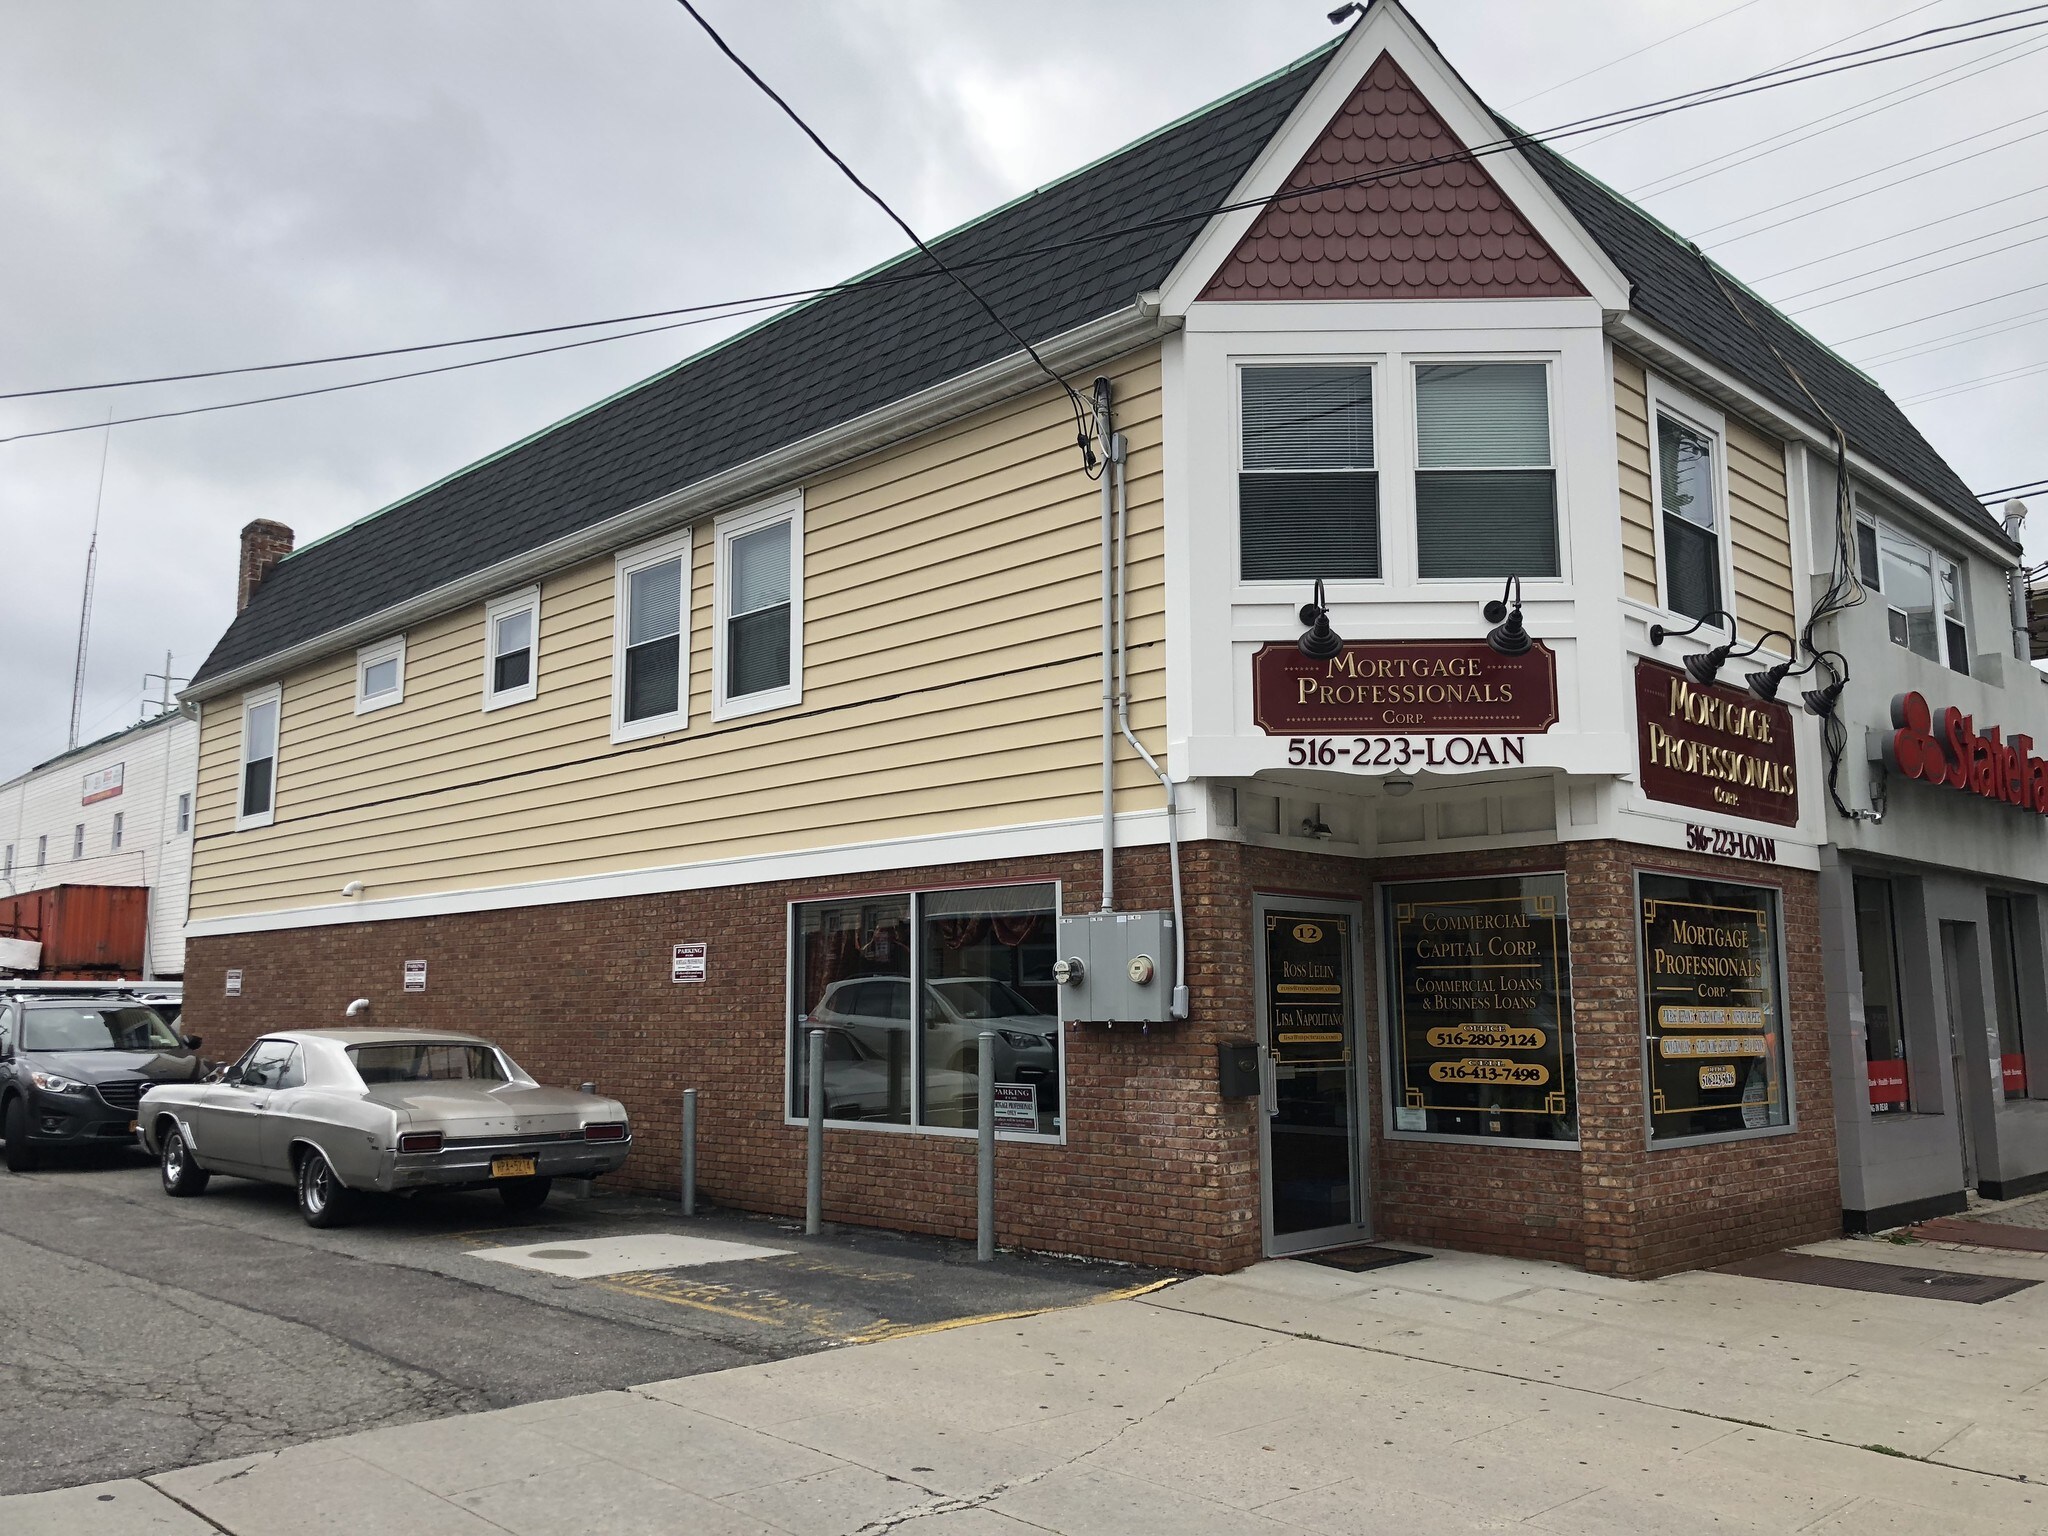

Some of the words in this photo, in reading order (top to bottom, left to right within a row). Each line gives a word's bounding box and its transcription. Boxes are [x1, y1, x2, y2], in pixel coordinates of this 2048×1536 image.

[1326, 652, 1482, 678] MORTGAGE
[1297, 677, 1513, 705] PROFESSIONALS
[1382, 710, 1426, 724] CORP.
[1669, 677, 1773, 744] MORTGAGE
[1288, 736, 1525, 766] 516-223-LOAN
[1648, 721, 1794, 796] PROFESSIONALS
[1940, 706, 2021, 806] State
[1686, 824, 1776, 862] 516-223-LOAN
[1298, 928, 1317, 938] 12
[1422, 912, 1531, 932] COMMERCIAL
[1672, 919, 1749, 949] MORTGAGE
[1417, 939, 1483, 959] CAPITAL
[1488, 937, 1541, 956] CORP.
[1655, 949, 1761, 978] PROFESSIONALS
[1415, 977, 1496, 993] COMMERCIAL
[1500, 976, 1542, 991] LOANS
[1698, 984, 1728, 998] CORP.
[1422, 998, 1432, 1010] &
[1435, 995, 1491, 1010] BUSINESS
[1494, 994, 1536, 1009] LOANS
[1276, 1009, 1294, 1027] LISA
[1436, 1033, 1537, 1048] 516-280-9124
[1439, 1066, 1541, 1082] 516-413-7498
